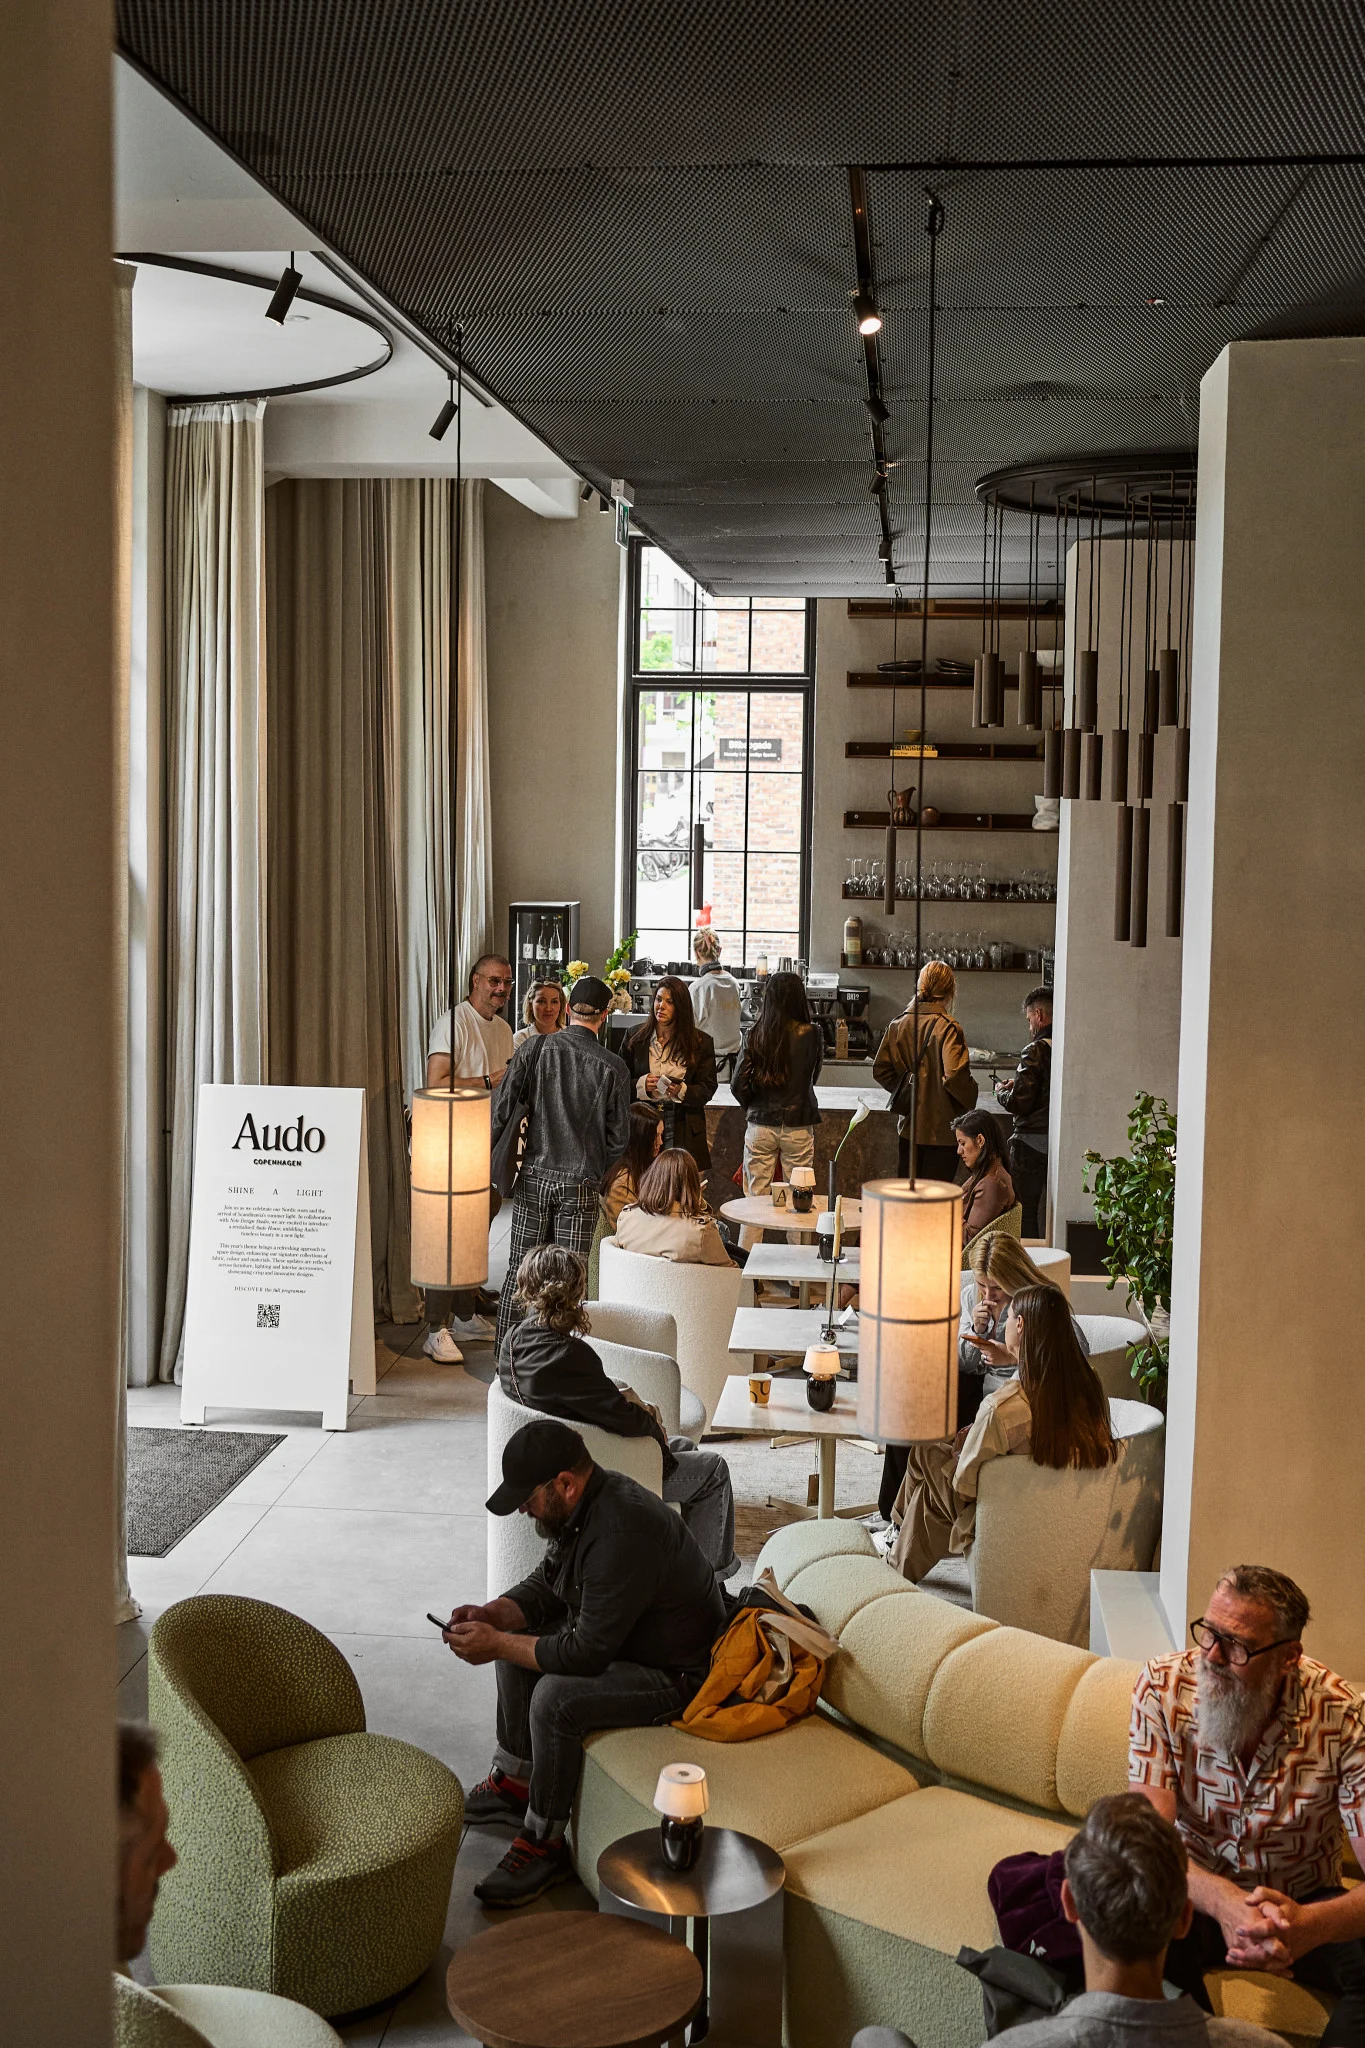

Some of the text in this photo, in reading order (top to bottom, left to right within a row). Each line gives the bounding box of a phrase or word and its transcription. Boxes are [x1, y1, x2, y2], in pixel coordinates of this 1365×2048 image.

[231, 1112, 326, 1154] Audo
[253, 1158, 302, 1167] COPENHAGEN
[227, 1186, 324, 1197] SHINE A LIGHT
